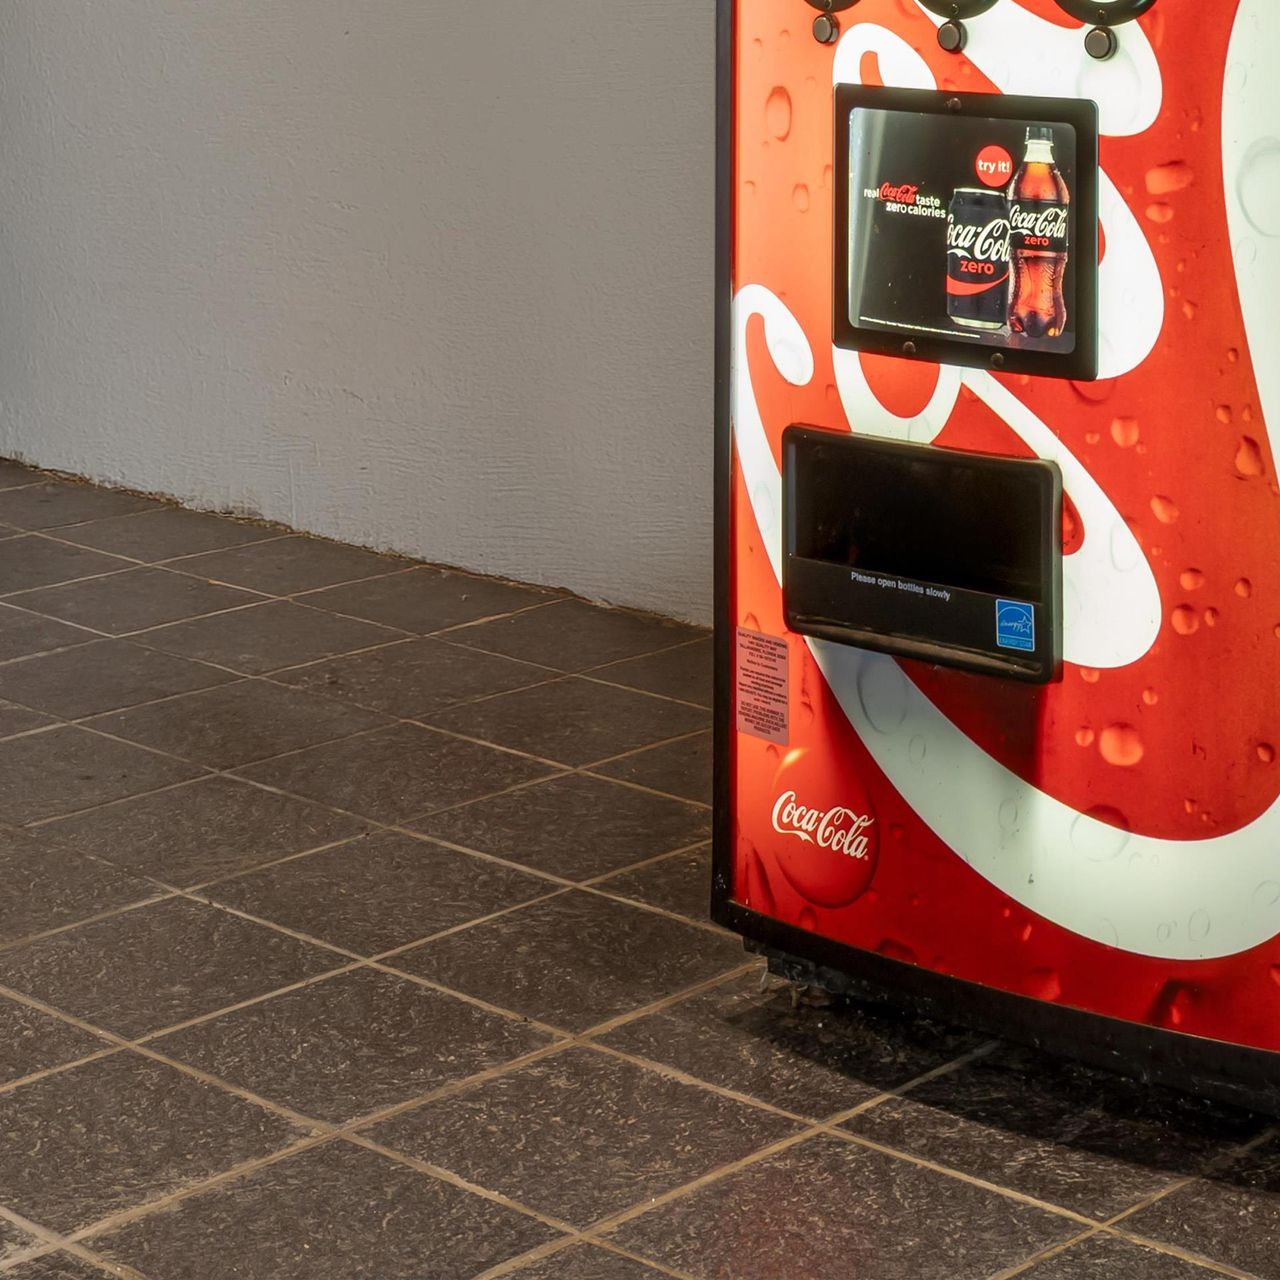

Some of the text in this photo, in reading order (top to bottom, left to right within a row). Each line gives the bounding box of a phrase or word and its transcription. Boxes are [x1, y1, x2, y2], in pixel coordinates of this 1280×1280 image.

[978, 160, 1010, 174] try it!
[863, 182, 940, 207] real Coca-Cola taste
[886, 202, 946, 219] zero calories
[1024, 236, 1050, 246] zero
[960, 260, 994, 274] zero
[851, 571, 951, 602] Please open bottles slowly
[772, 790, 875, 858] Coca-Cola
